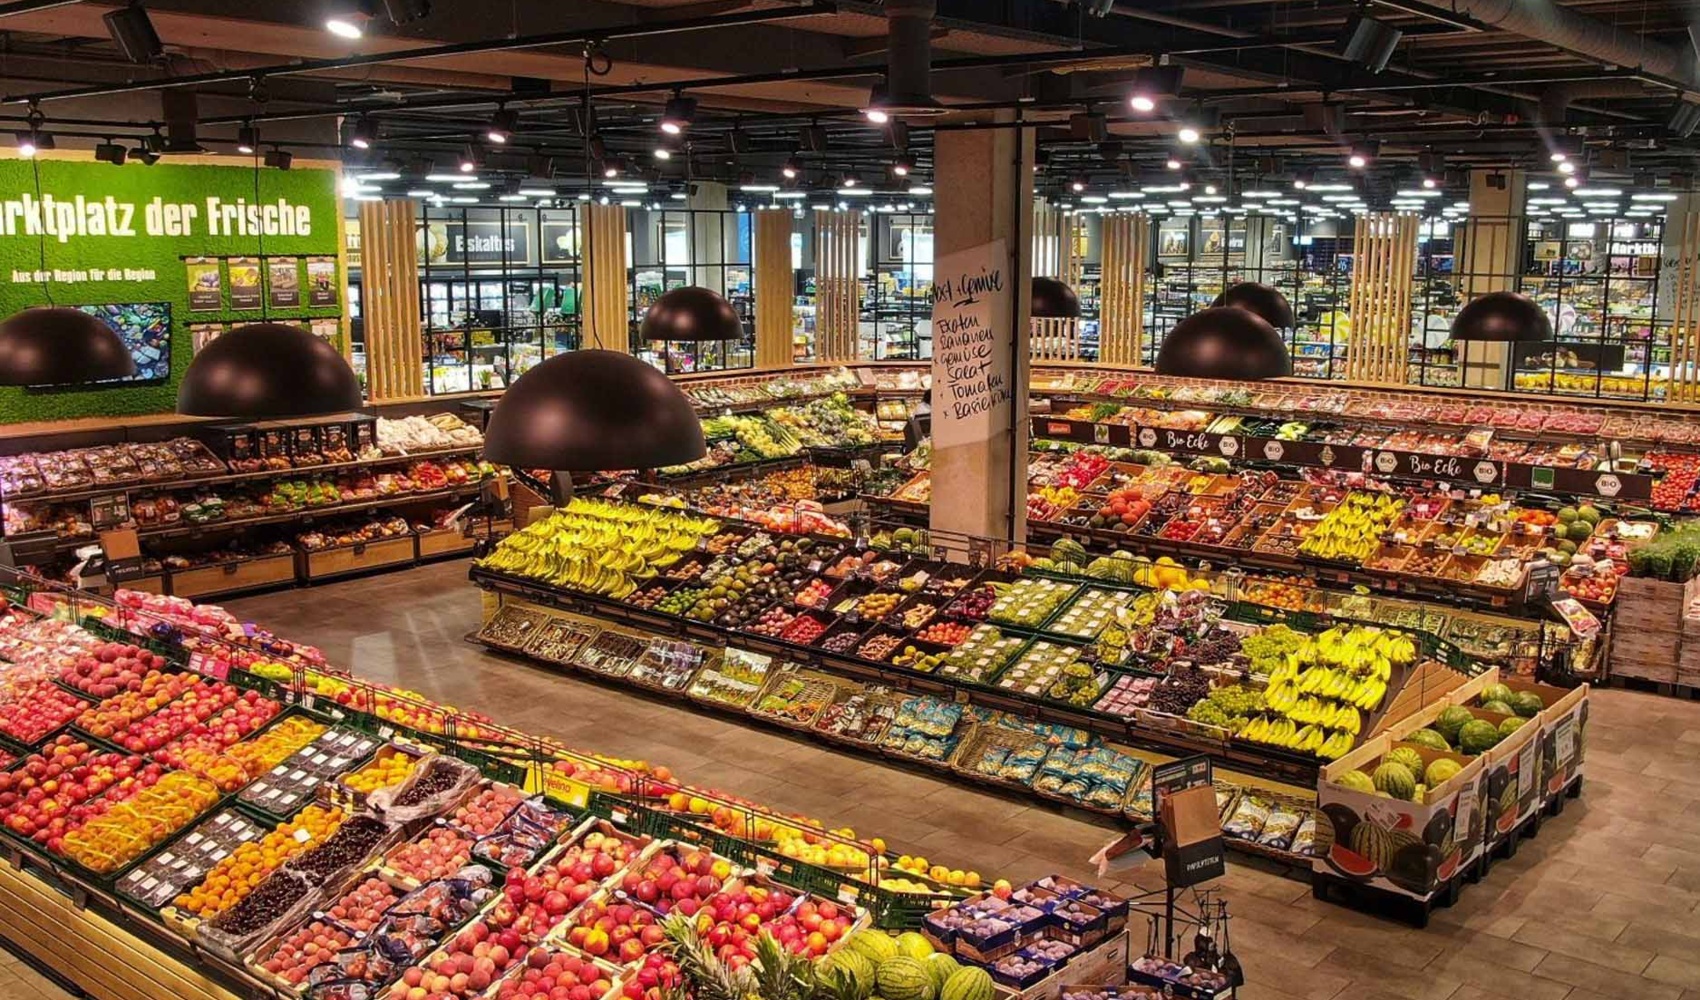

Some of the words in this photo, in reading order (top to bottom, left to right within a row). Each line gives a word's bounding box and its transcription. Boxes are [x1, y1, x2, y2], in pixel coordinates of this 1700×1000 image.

[145, 197, 198, 236] der
[206, 197, 311, 236] Frische
[12, 270, 31, 283] Aus
[33, 270, 51, 282] der
[54, 269, 87, 283] Region
[89, 268, 105, 282] für
[107, 268, 122, 281] die
[124, 268, 156, 282] Region
[1166, 430, 1185, 448] Bio
[1186, 432, 1210, 450] Ecke
[1409, 455, 1432, 474] Bio
[1433, 457, 1461, 476] Ecke
